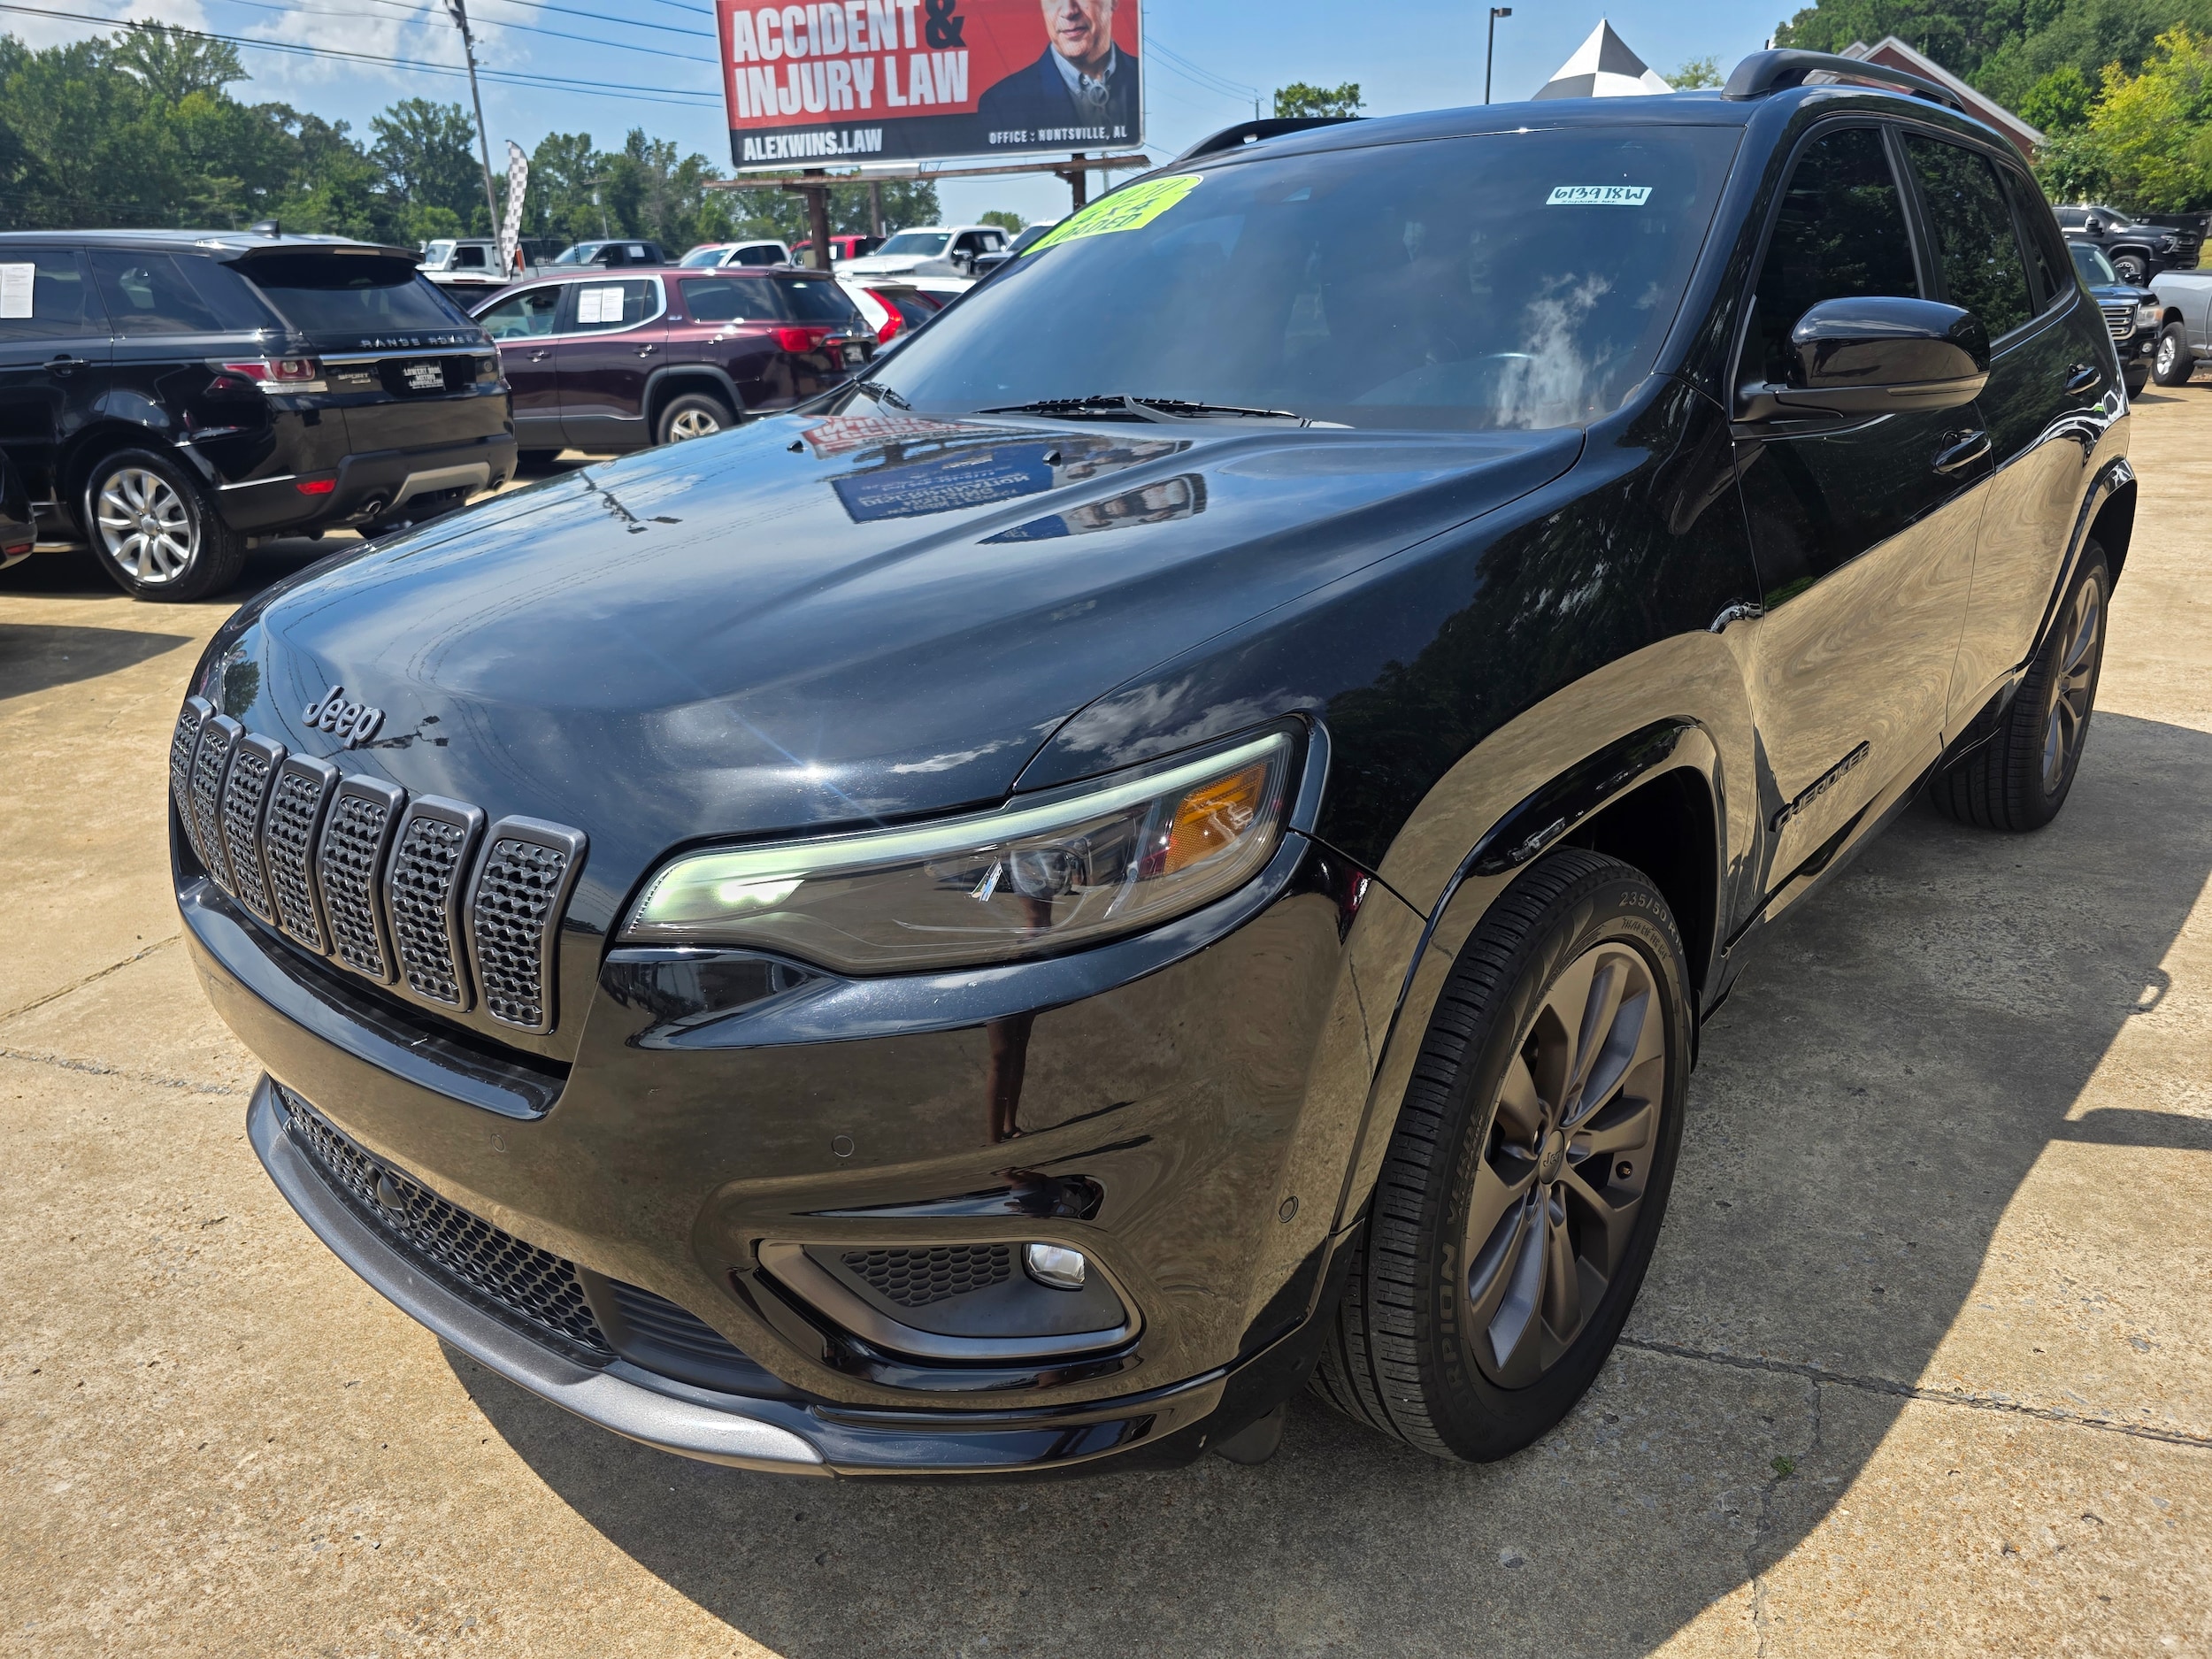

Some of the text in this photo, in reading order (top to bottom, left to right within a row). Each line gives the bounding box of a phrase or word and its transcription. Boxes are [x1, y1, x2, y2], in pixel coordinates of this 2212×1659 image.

[733, 0, 967, 63] ACCIDENT &
[735, 50, 969, 119] INJURY LAW
[743, 128, 883, 161] ALEXWINS.LAW
[988, 130, 1027, 145] OFFICE
[1113, 126, 1127, 139] AL
[302, 685, 386, 749] Jeep
[1769, 740, 1870, 833] CHEROKEE
[1618, 891, 1667, 923] 235/50
